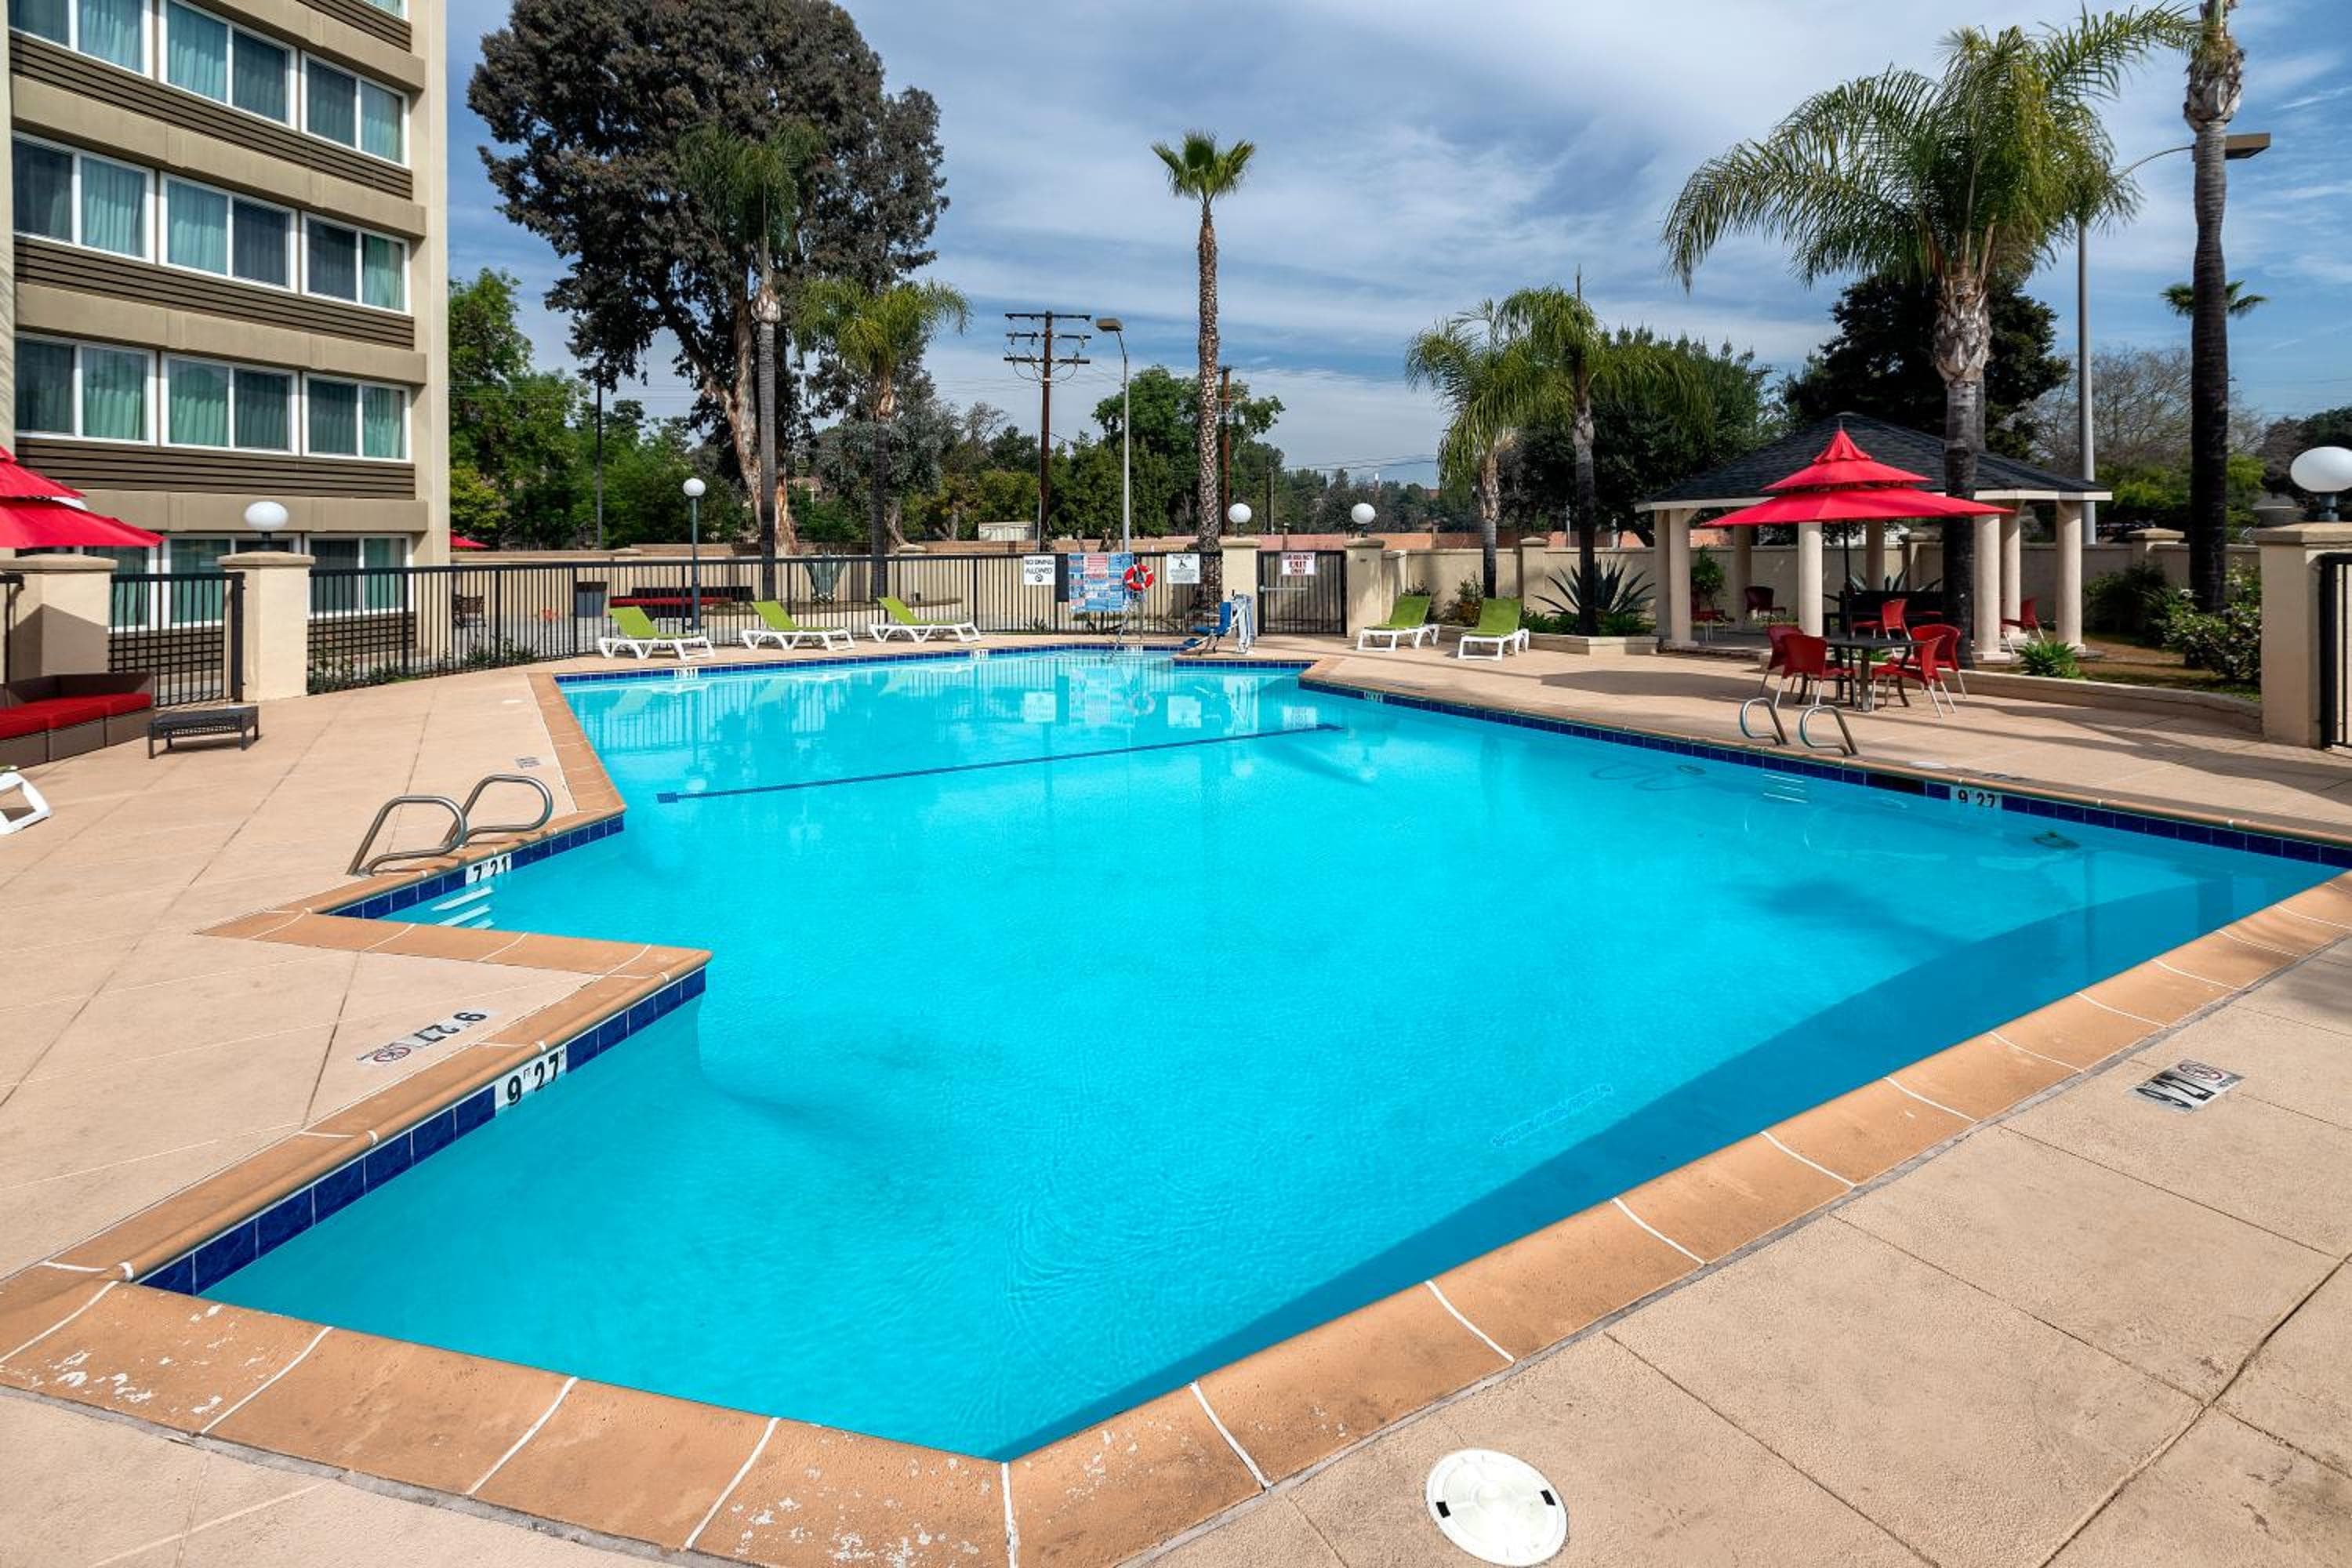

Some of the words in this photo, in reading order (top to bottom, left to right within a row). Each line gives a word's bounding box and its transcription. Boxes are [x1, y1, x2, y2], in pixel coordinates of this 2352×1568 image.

[1958, 789, 1969, 804] 9
[473, 863, 482, 883] 7
[507, 1075, 521, 1106] 9
